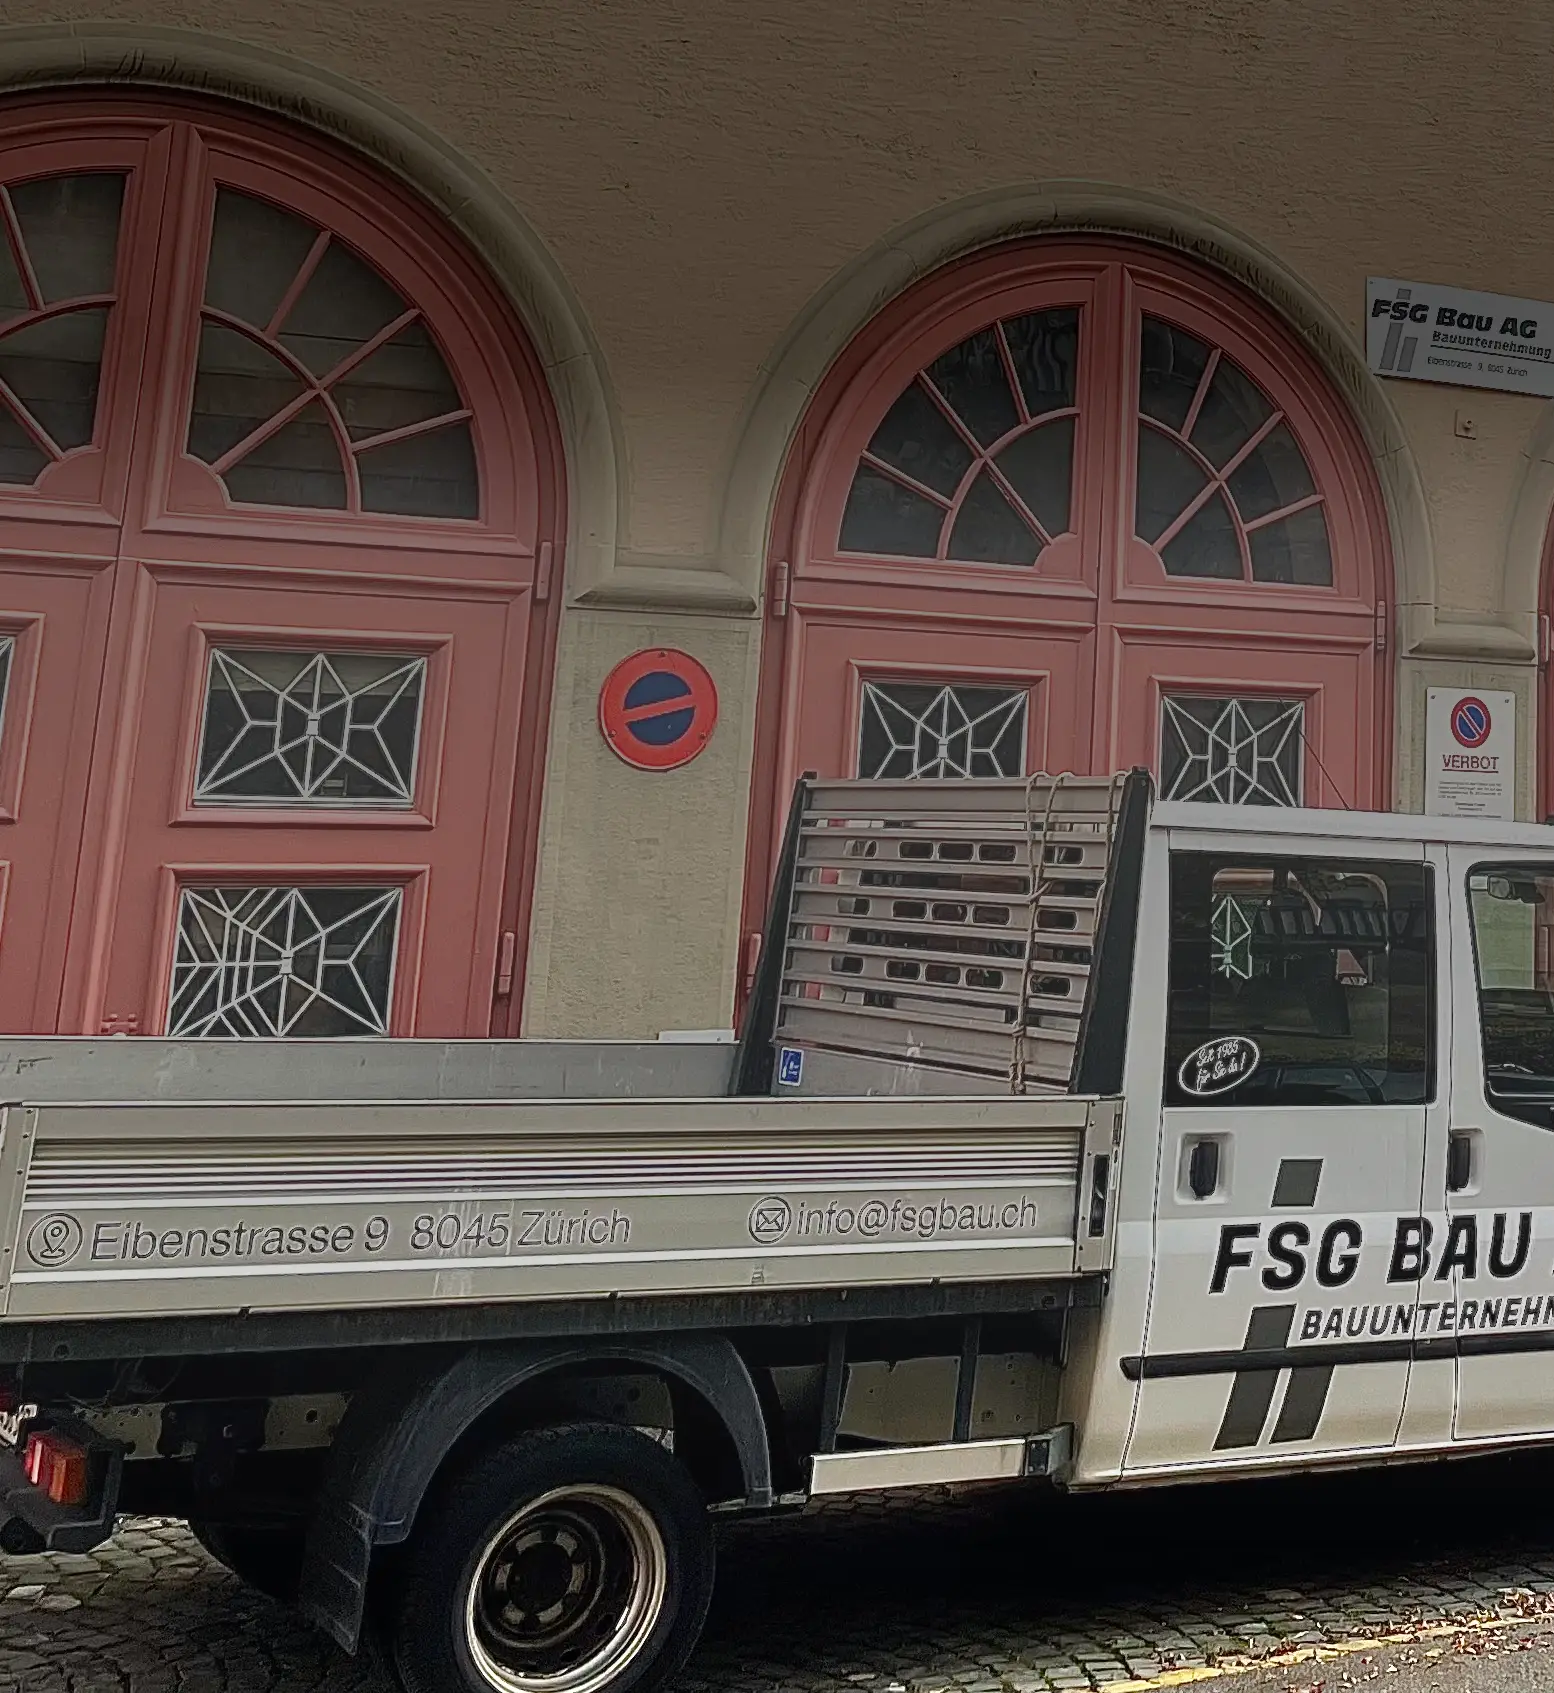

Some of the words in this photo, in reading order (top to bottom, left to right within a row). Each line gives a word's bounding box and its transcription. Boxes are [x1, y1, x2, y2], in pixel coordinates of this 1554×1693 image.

[1371, 298, 1430, 324] FSG
[1435, 306, 1494, 332] Bau
[1499, 317, 1538, 339] AG
[1432, 330, 1552, 359] Bauunternehmung
[1442, 754, 1500, 770] VERBOT
[89, 1217, 356, 1262] Eibenstrasse
[365, 1216, 390, 1254] 9
[409, 1212, 509, 1251] 8045
[515, 1207, 631, 1246] Zürich
[797, 1196, 1038, 1239] info@fsgbau.ch
[1208, 1219, 1363, 1295] FSG
[1387, 1212, 1533, 1285] BAU
